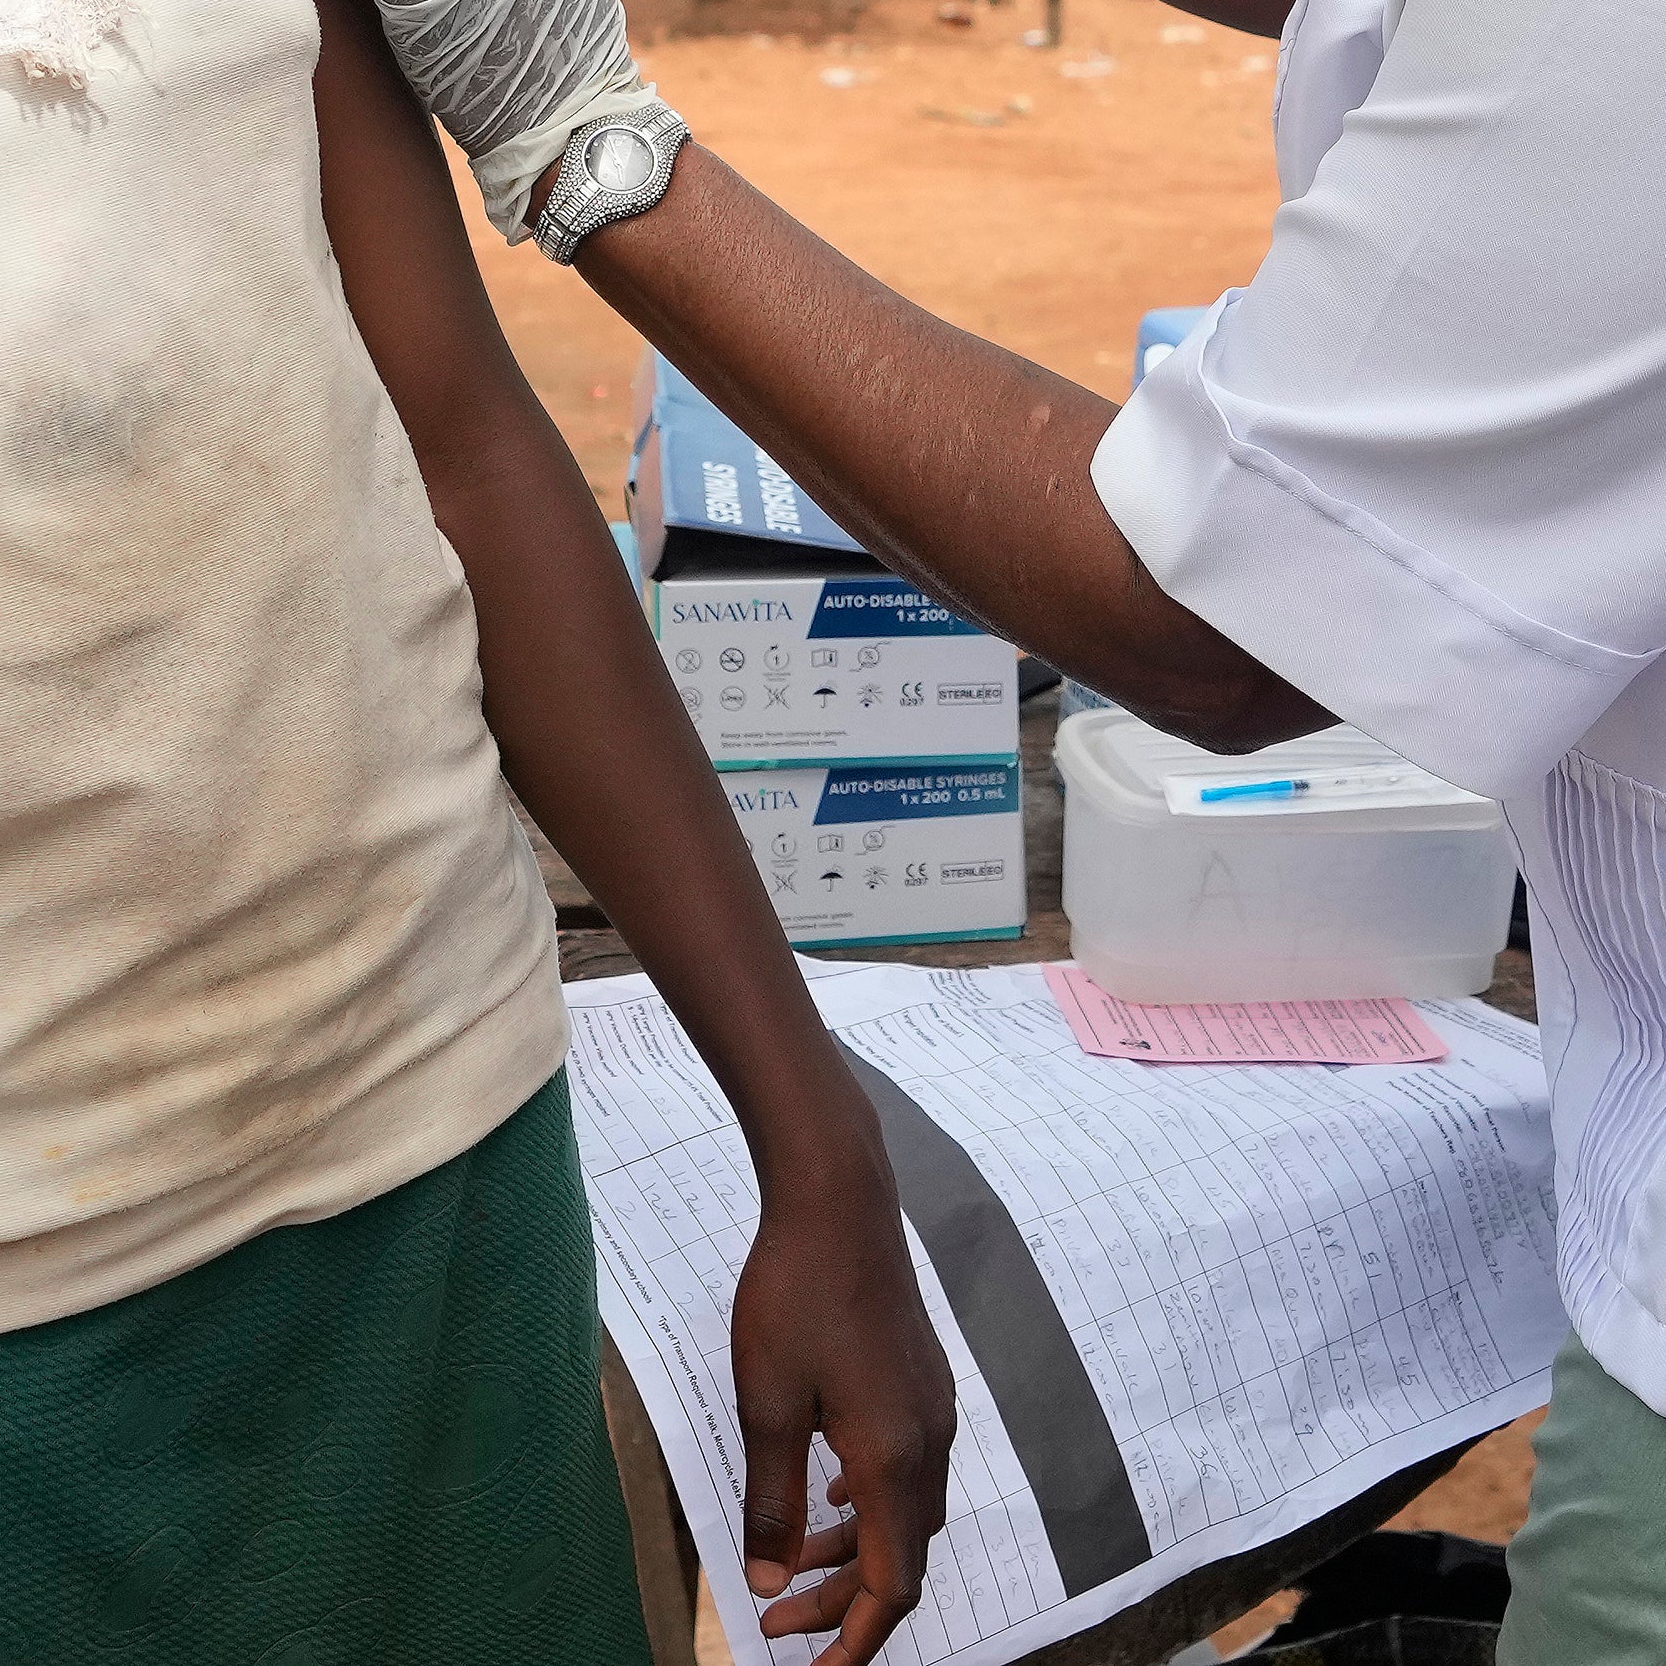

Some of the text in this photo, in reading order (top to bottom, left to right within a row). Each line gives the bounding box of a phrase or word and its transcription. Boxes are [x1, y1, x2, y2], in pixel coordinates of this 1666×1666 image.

[702, 461, 743, 526] SYRINGES
[896, 609, 904, 622] 1
[919, 609, 950, 622] 200
[829, 772, 1008, 795] AUTO-DISABLE SYRINGES
[900, 793, 908, 805] 1
[921, 792, 951, 804] 200
[957, 789, 982, 802] 0.5
[639, 1181, 678, 1227] 124
[674, 1291, 697, 1322] 2
[667, 1332, 678, 1342] of
[671, 1341, 694, 1375] Transport
[686, 1374, 707, 1409] Required
[703, 1412, 718, 1435] Walk,
[712, 1433, 734, 1480] Motorcycle,
[727, 1478, 742, 1500] Keke
